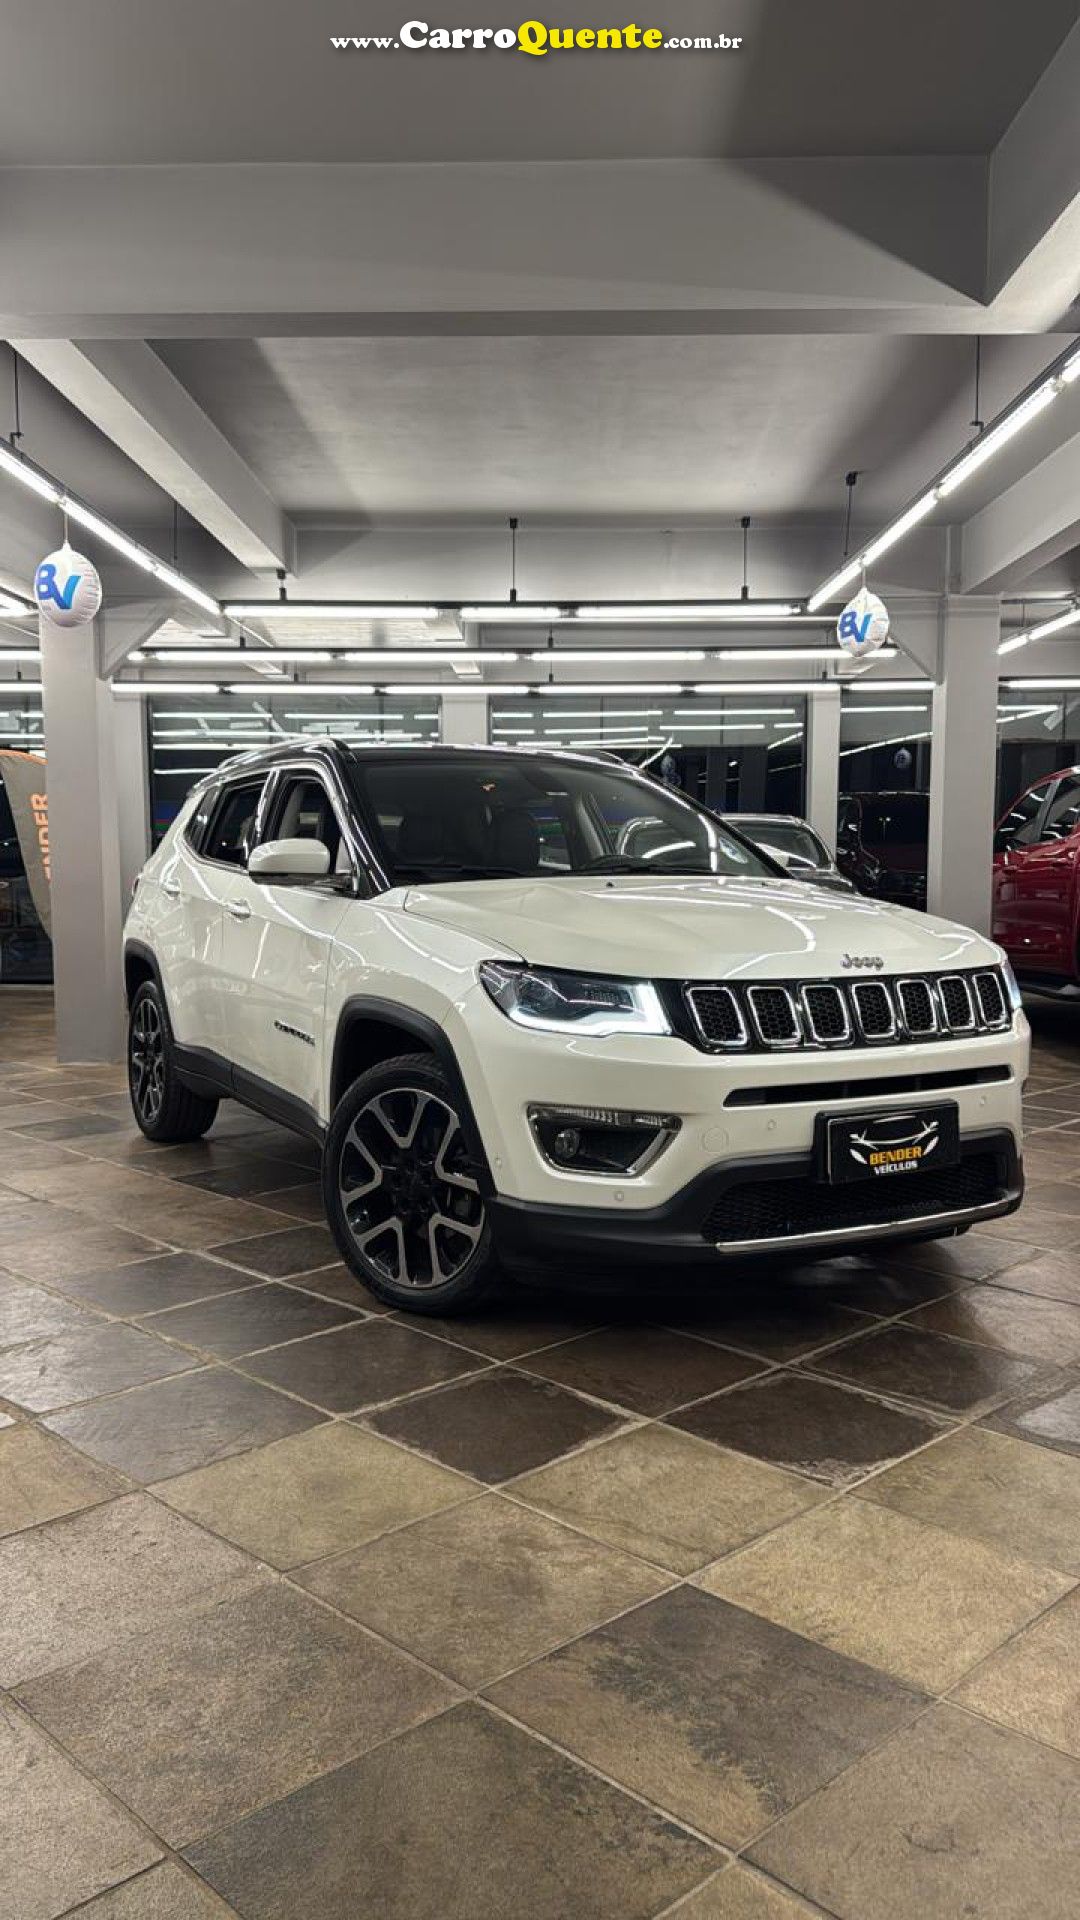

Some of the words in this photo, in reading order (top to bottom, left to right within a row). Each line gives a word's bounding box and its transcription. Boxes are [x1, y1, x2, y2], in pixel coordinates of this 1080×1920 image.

[36, 563, 82, 610] BV
[839, 611, 873, 643] BV
[841, 953, 884, 971] Jeep
[869, 1145, 922, 1166] BENDER
